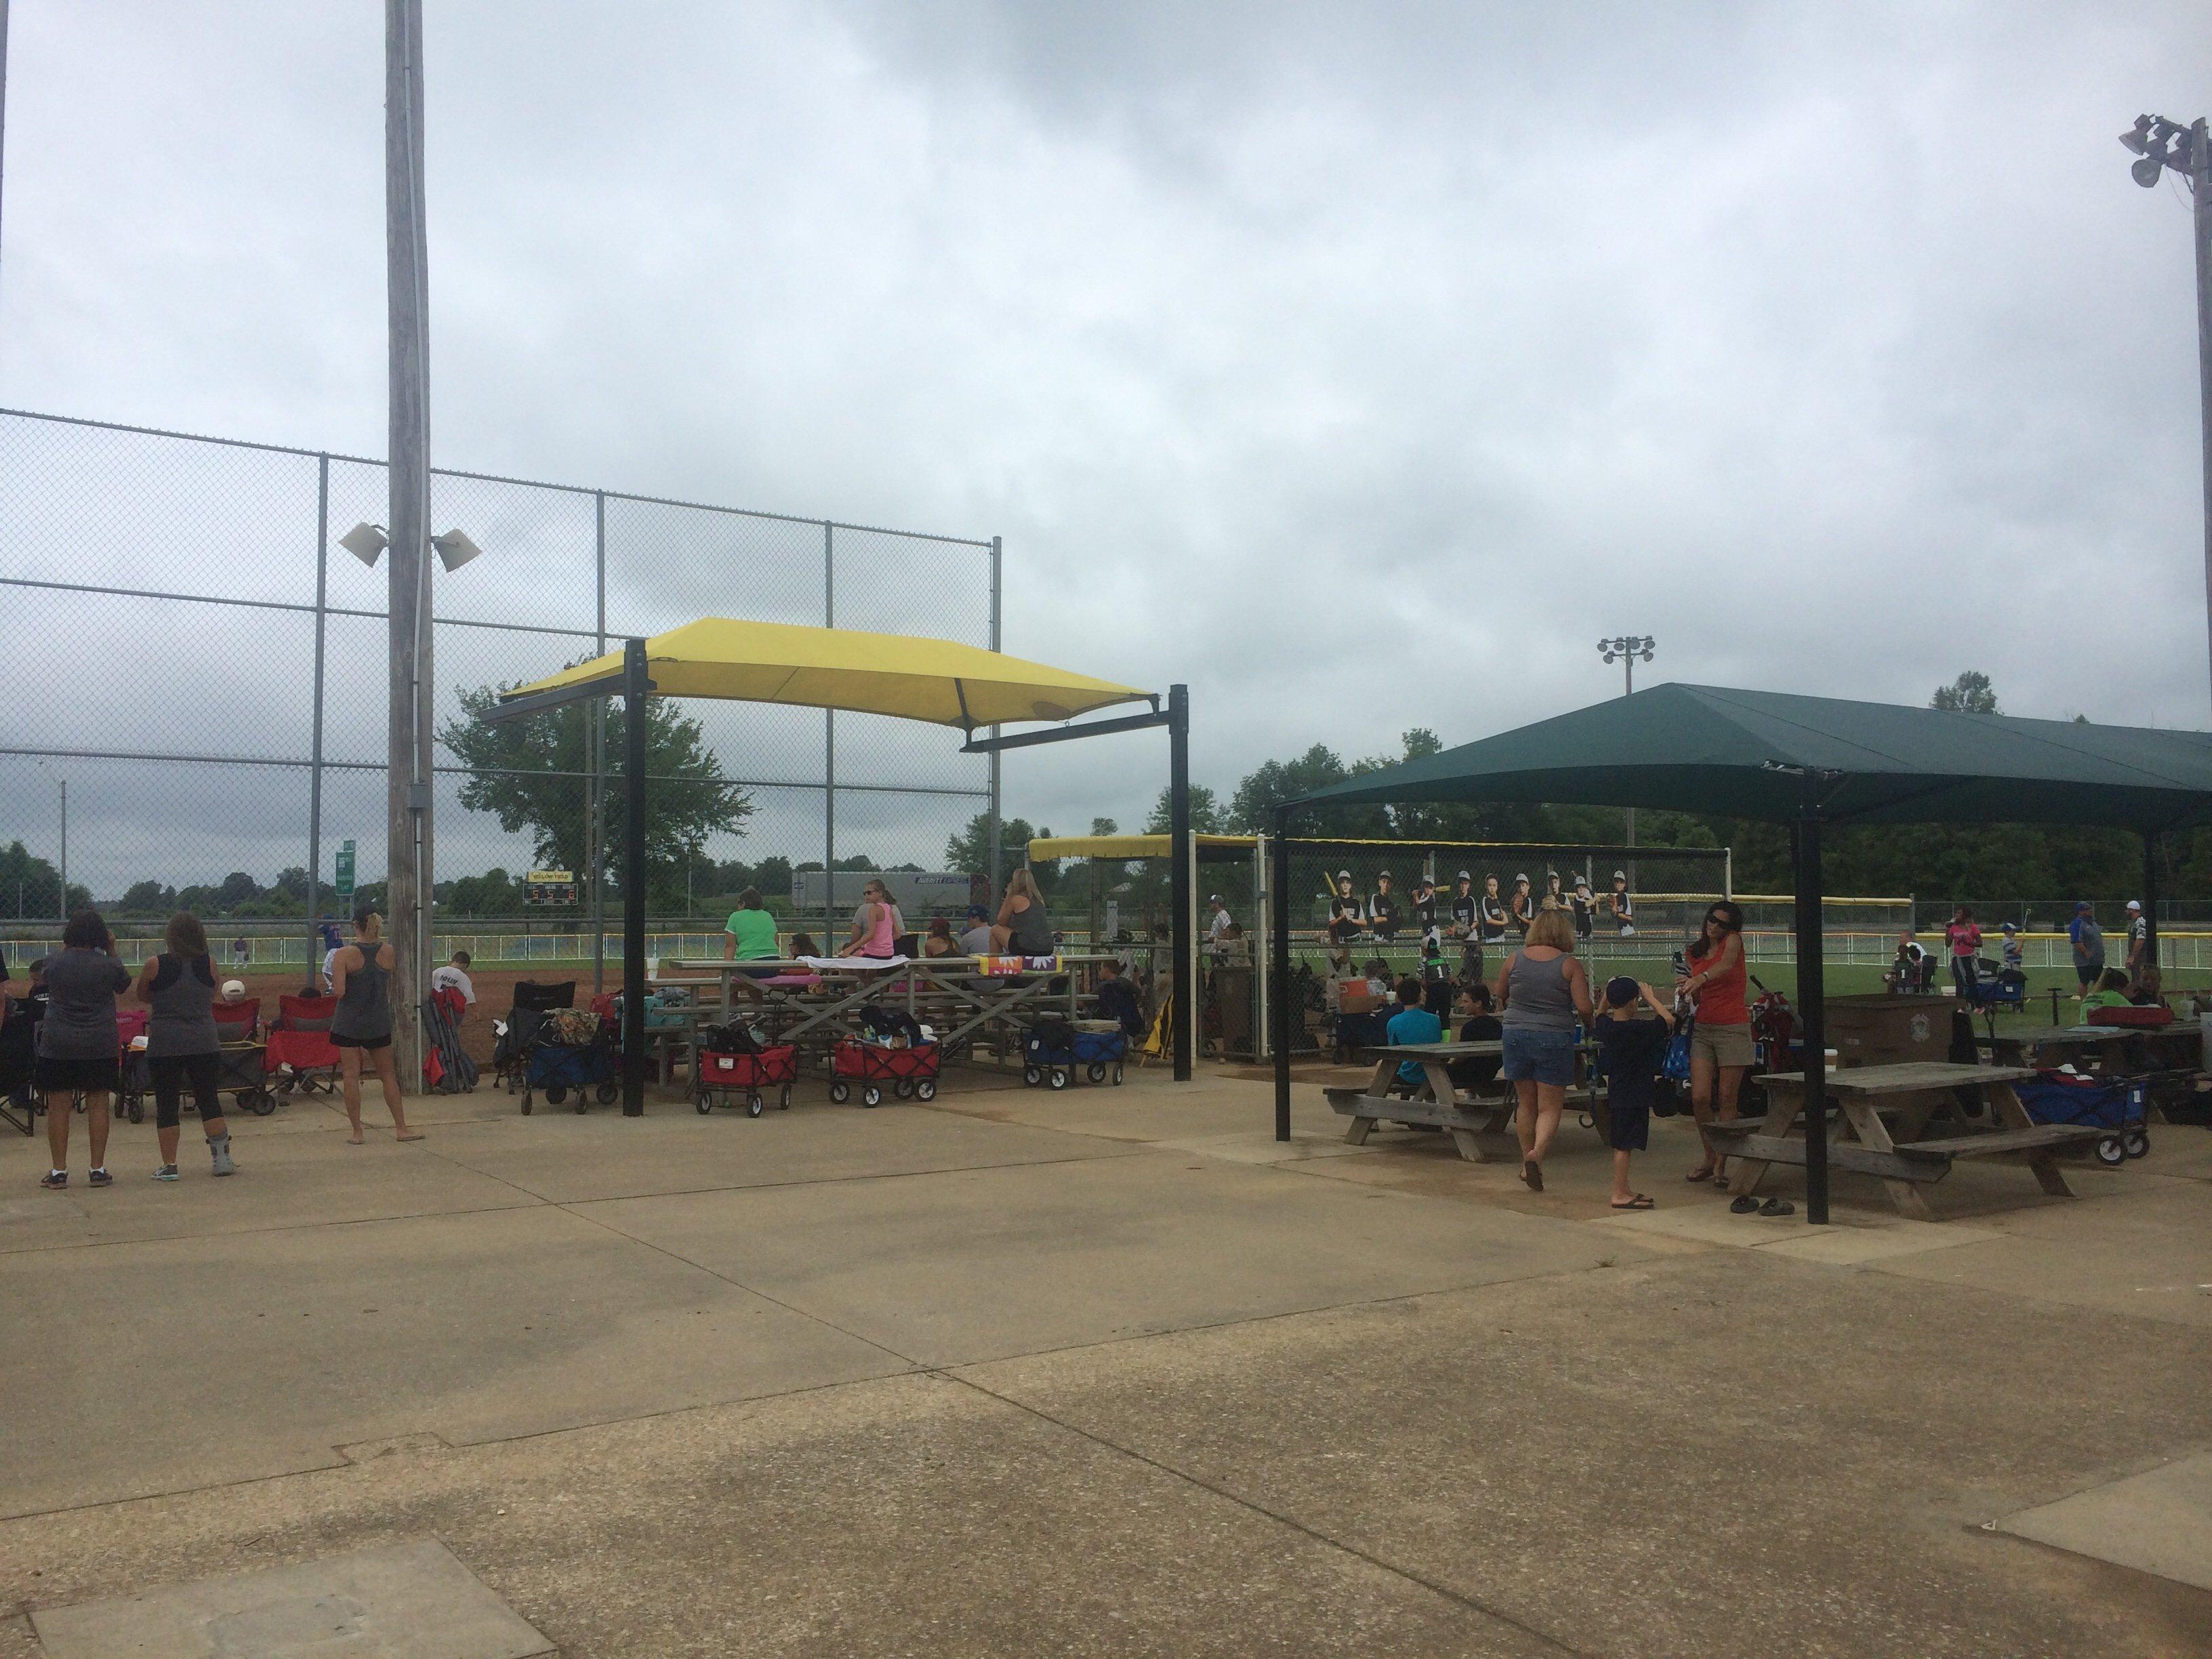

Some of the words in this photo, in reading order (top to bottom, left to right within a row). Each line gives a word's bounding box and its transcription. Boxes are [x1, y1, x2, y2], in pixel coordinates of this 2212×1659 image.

[533, 889, 539, 900] 5
[548, 890, 553, 900] 5
[1437, 966, 1443, 978] 1
[1901, 969, 1906, 979] 1
